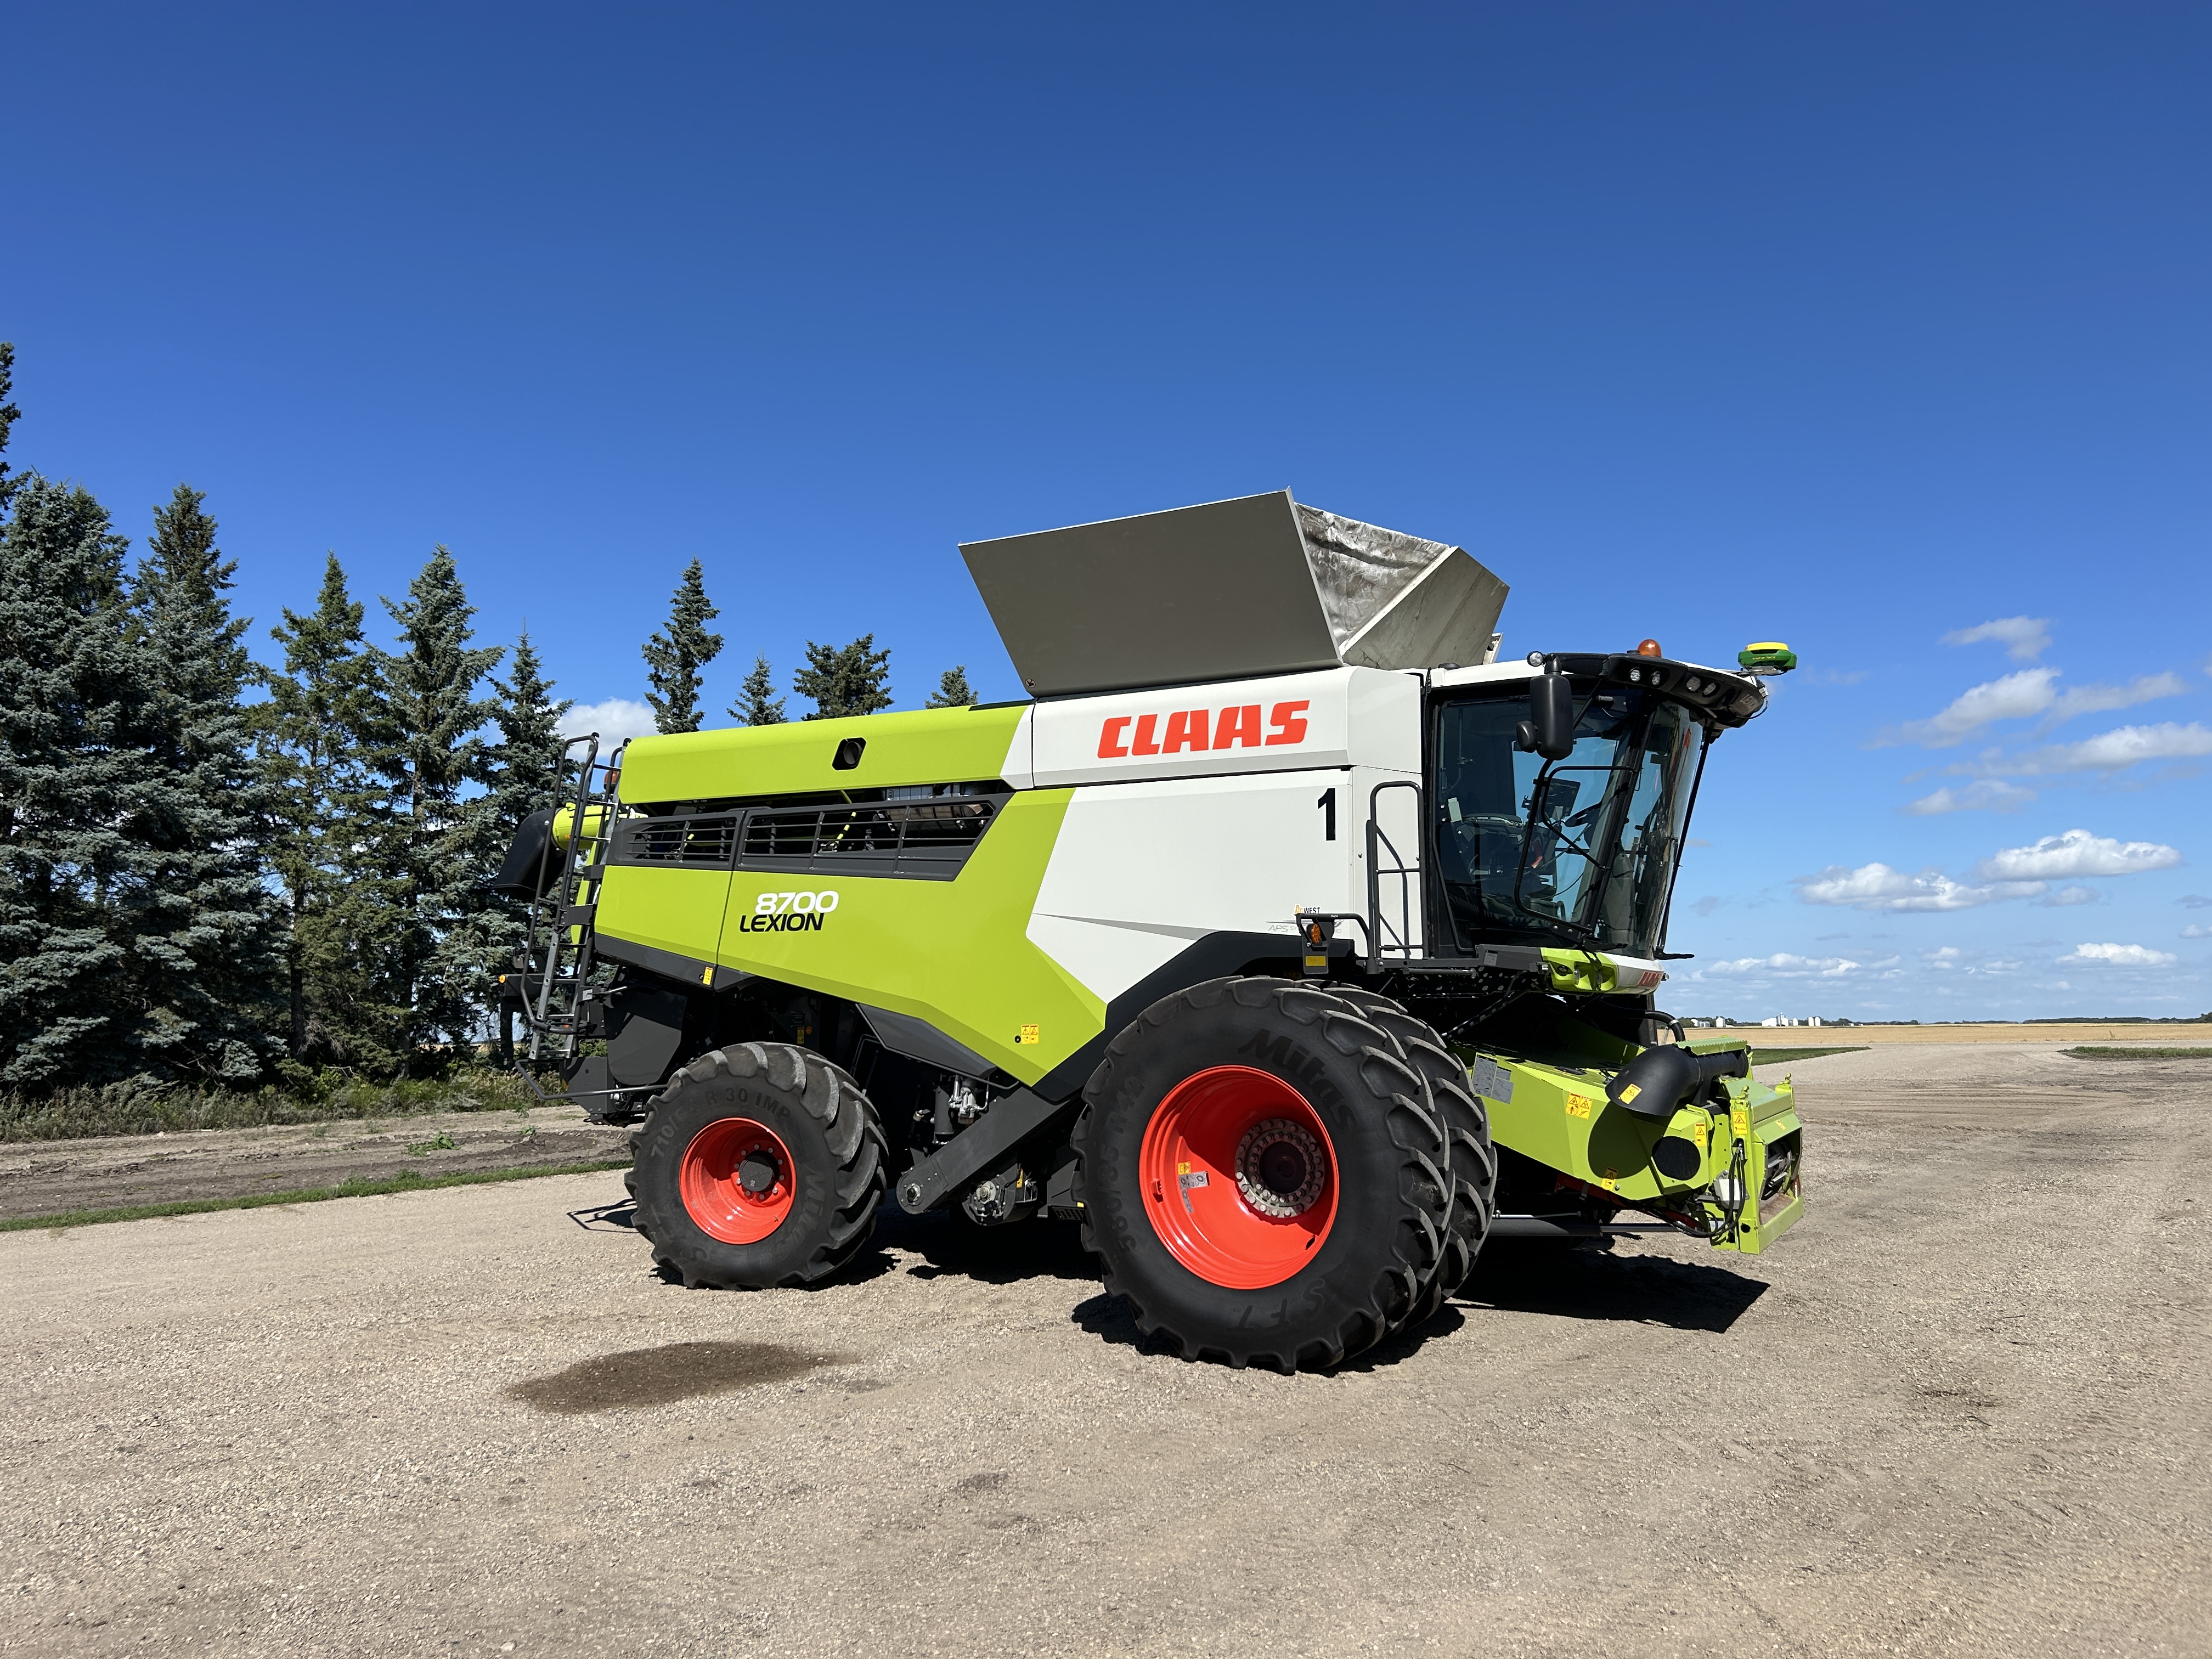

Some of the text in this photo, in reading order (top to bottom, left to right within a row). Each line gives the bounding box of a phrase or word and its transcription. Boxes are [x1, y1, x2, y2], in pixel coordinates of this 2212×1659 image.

[1097, 700, 1310, 759] CLAAS
[1318, 788, 1336, 841] 1
[740, 912, 825, 933] LEXION
[755, 890, 839, 915] 8700
[1268, 924, 1289, 933] APS
[725, 1087, 749, 1103] 30
[755, 1091, 792, 1120] IMP
[1237, 1028, 1359, 1135] Mitas
[771, 1159, 826, 1261] Mitas
[1098, 1144, 1136, 1251] 580/85
